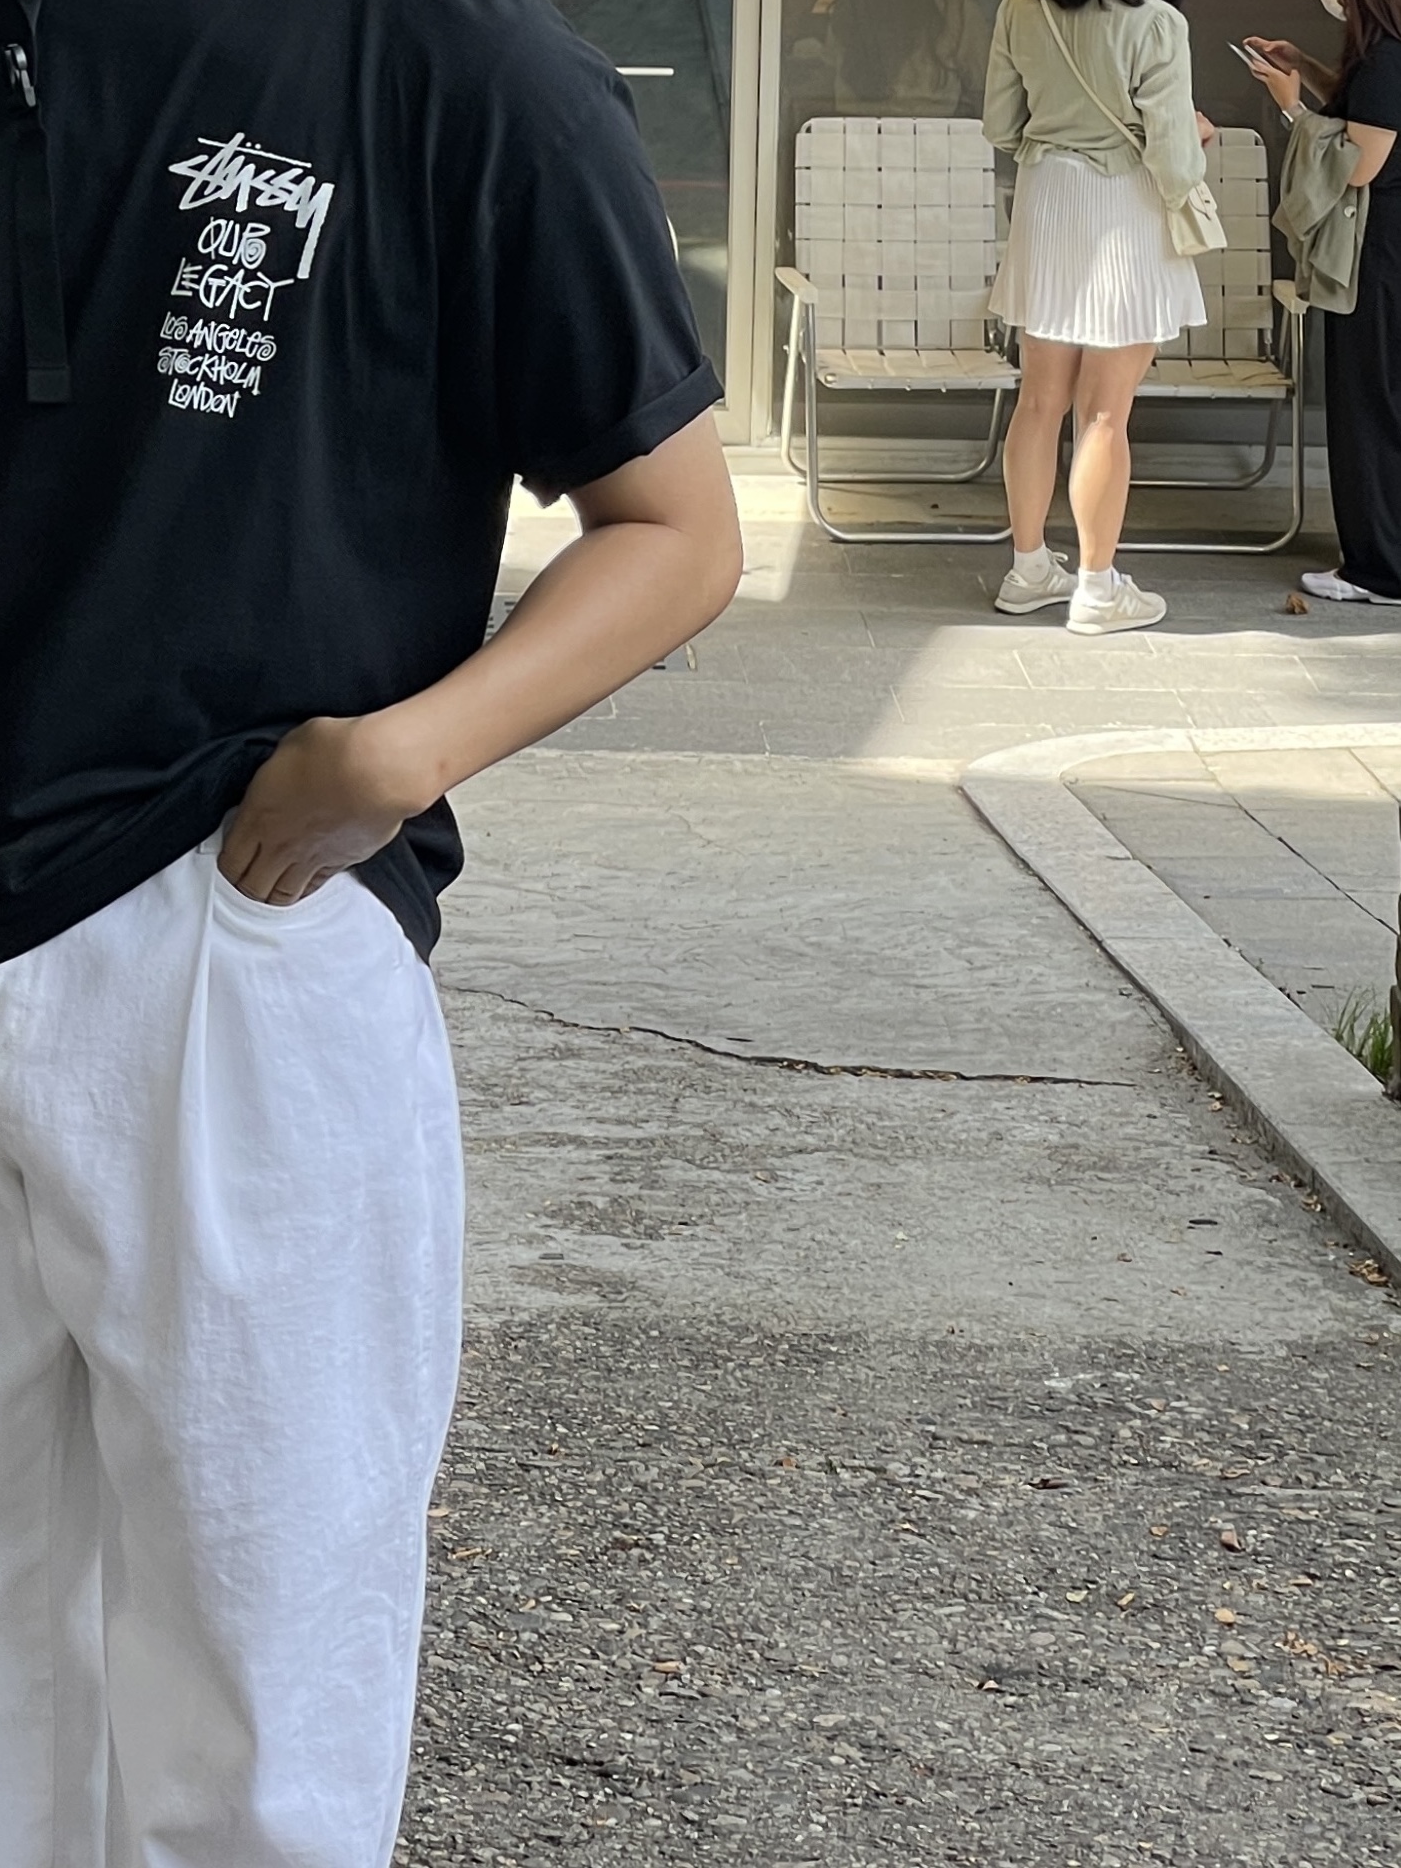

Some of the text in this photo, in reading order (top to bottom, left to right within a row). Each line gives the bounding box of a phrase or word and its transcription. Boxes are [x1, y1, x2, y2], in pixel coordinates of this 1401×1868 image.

[170, 257, 294, 321] LEGACY
[157, 346, 261, 396] STOCKHOLM
[168, 378, 241, 418] LONDON
